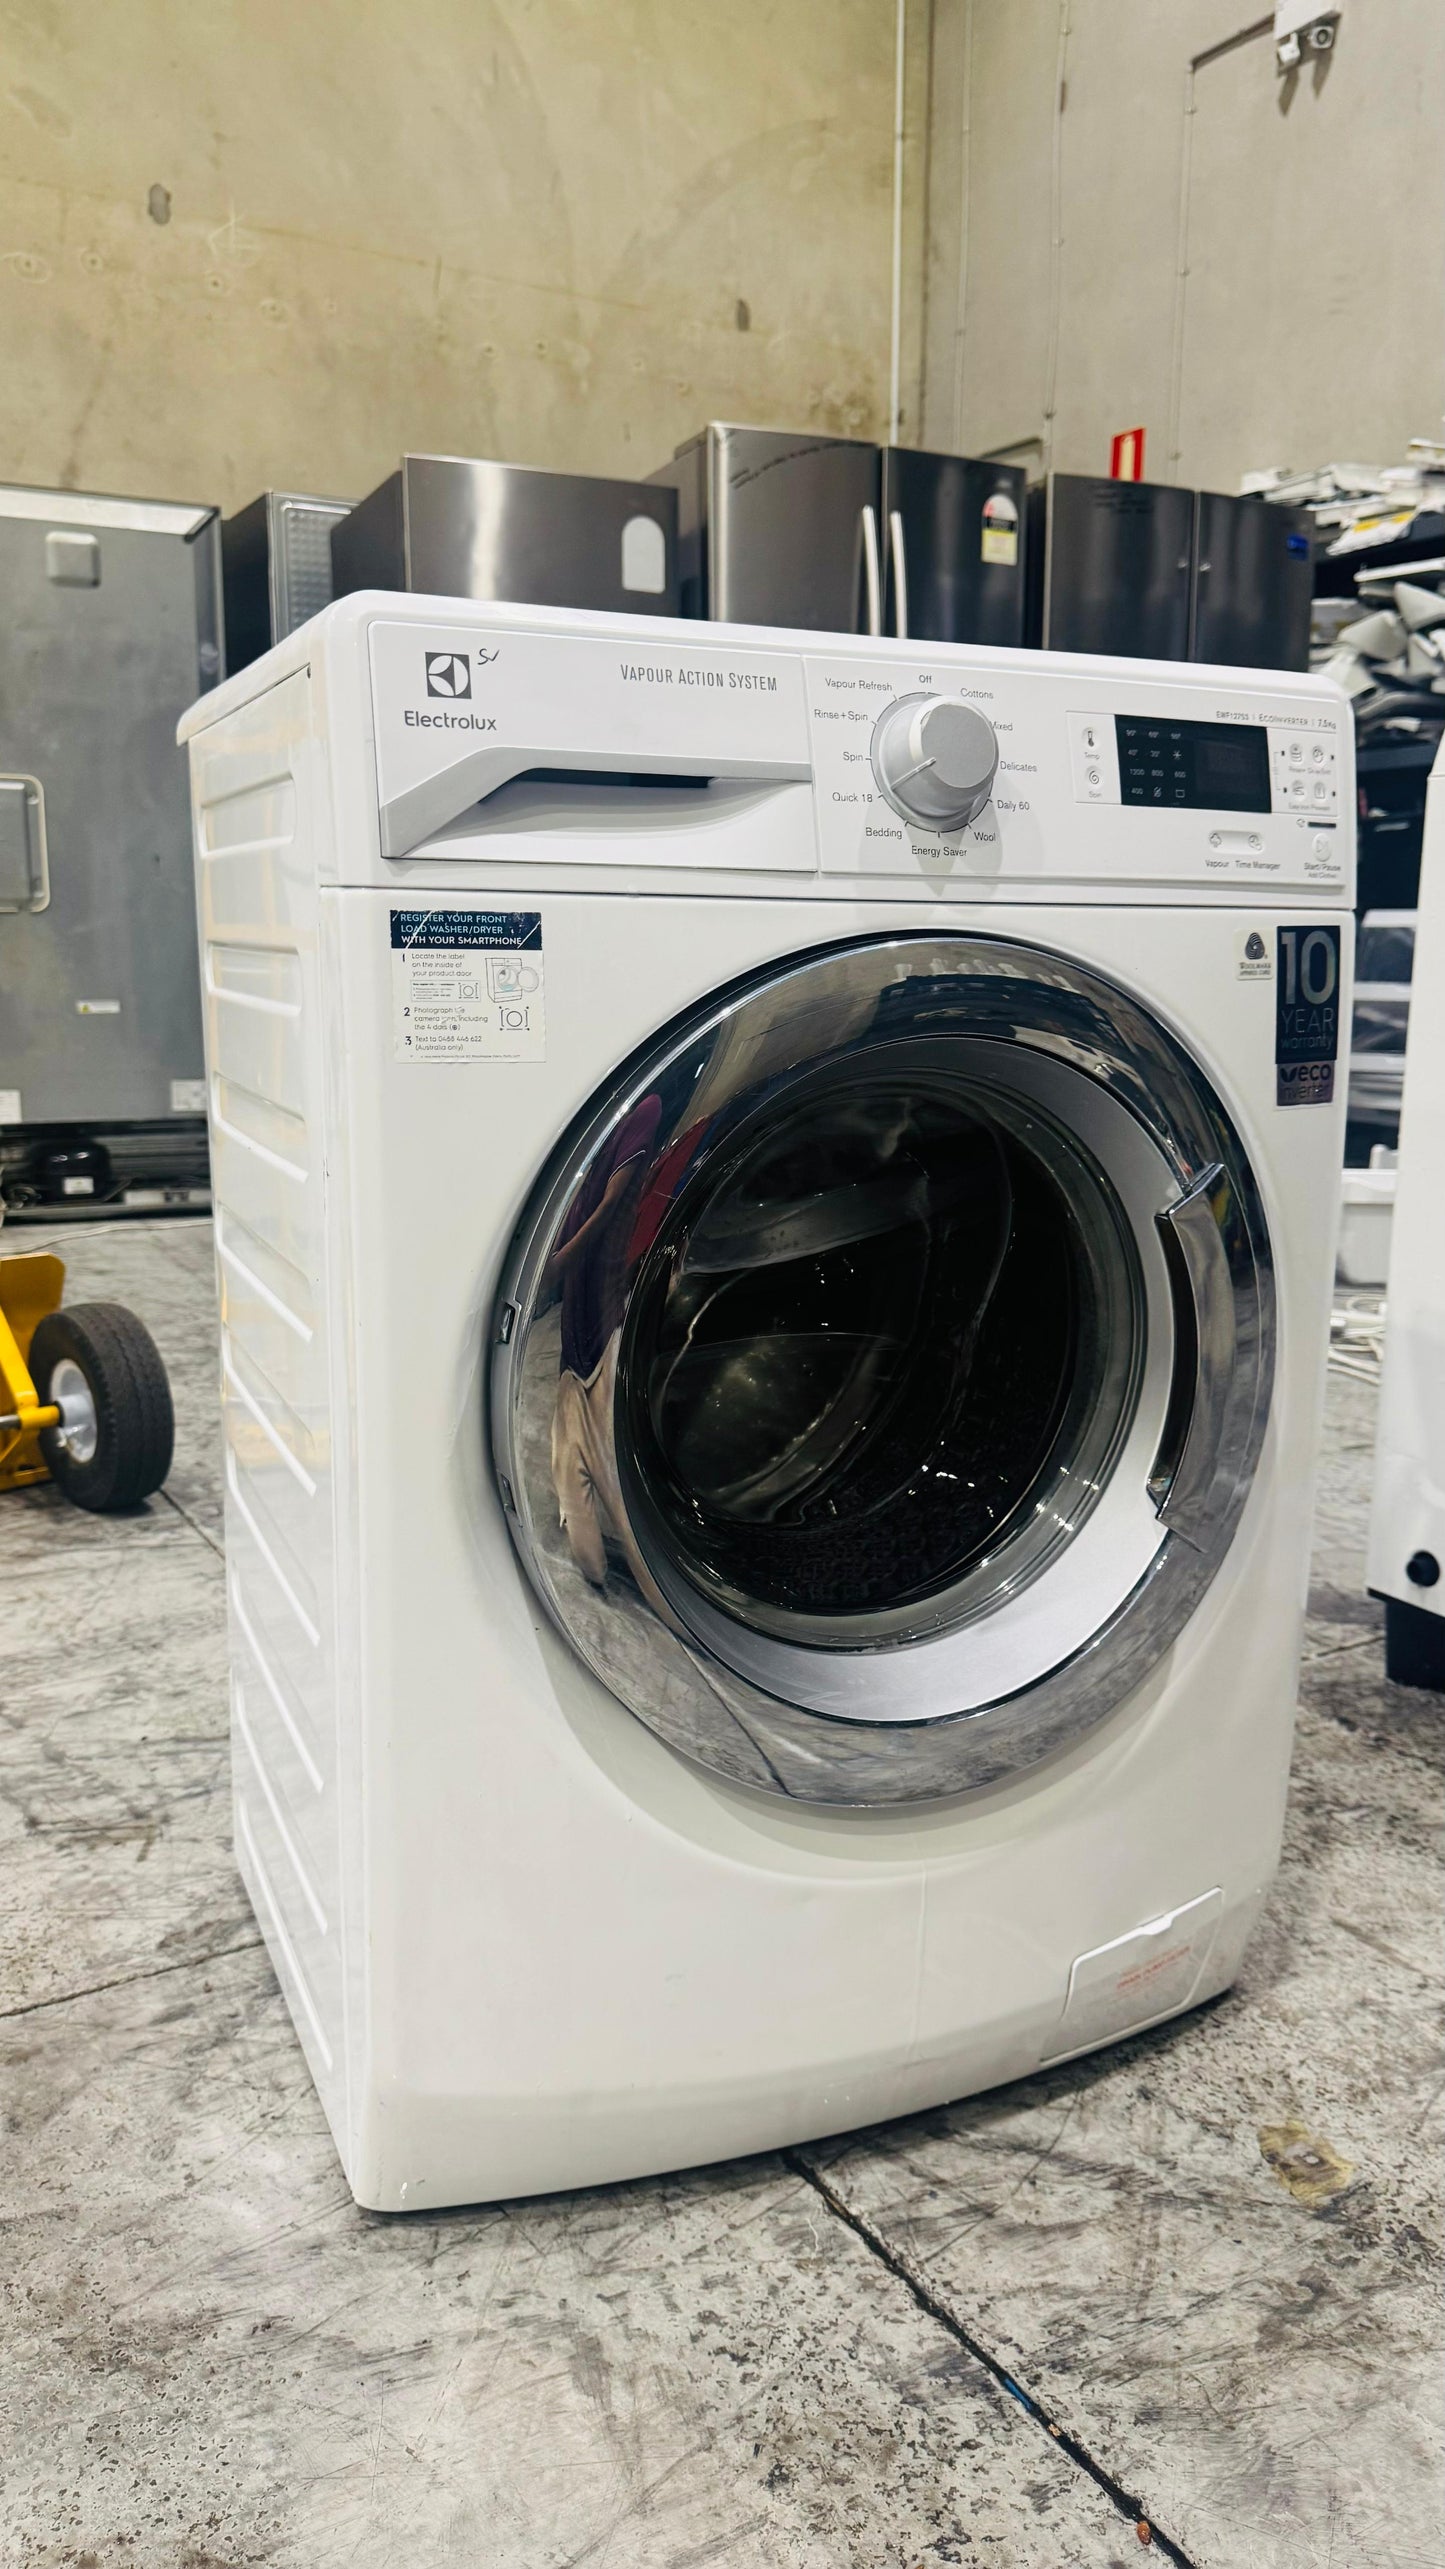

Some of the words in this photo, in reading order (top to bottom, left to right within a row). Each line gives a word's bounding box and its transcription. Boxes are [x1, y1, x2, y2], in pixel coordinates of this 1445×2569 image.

[620, 664, 673, 684] VAPOUR
[678, 668, 724, 687] ACTION
[728, 672, 777, 691] SYSTEM
[919, 675, 932, 684] Off
[825, 678, 856, 690] Vapour
[859, 681, 892, 691] Refresh
[960, 688, 993, 699] Cottons
[404, 710, 497, 731] Electrolux
[843, 752, 863, 762] Spin
[1000, 761, 1038, 773] Delicates
[832, 792, 858, 802] Quick
[862, 794, 873, 802] 18
[997, 800, 1016, 811] Daily
[1019, 802, 1030, 810] 60
[866, 827, 902, 839] Bedding
[974, 832, 995, 842] Wool
[911, 846, 941, 857] Energy
[943, 847, 967, 857] Saver
[1205, 860, 1230, 868] Vapour
[1236, 860, 1252, 868] Time
[1253, 861, 1280, 871] Manager
[400, 914, 444, 922] REGISTER
[447, 914, 472, 922] YOUR
[476, 915, 507, 923] FRONT
[401, 925, 427, 933] LOAD
[430, 925, 503, 934] WASHER/DRYER
[401, 936, 426, 944] WITH
[429, 936, 455, 944] YOUR
[458, 936, 522, 945] SMARTPHONE
[1281, 931, 1336, 1005] 10
[404, 1007, 410, 1016] 2
[1281, 1008, 1334, 1033] YEAR
[405, 1036, 412, 1045] 3
[1281, 1034, 1334, 1051] warranty
[1298, 1065, 1332, 1081] eco
